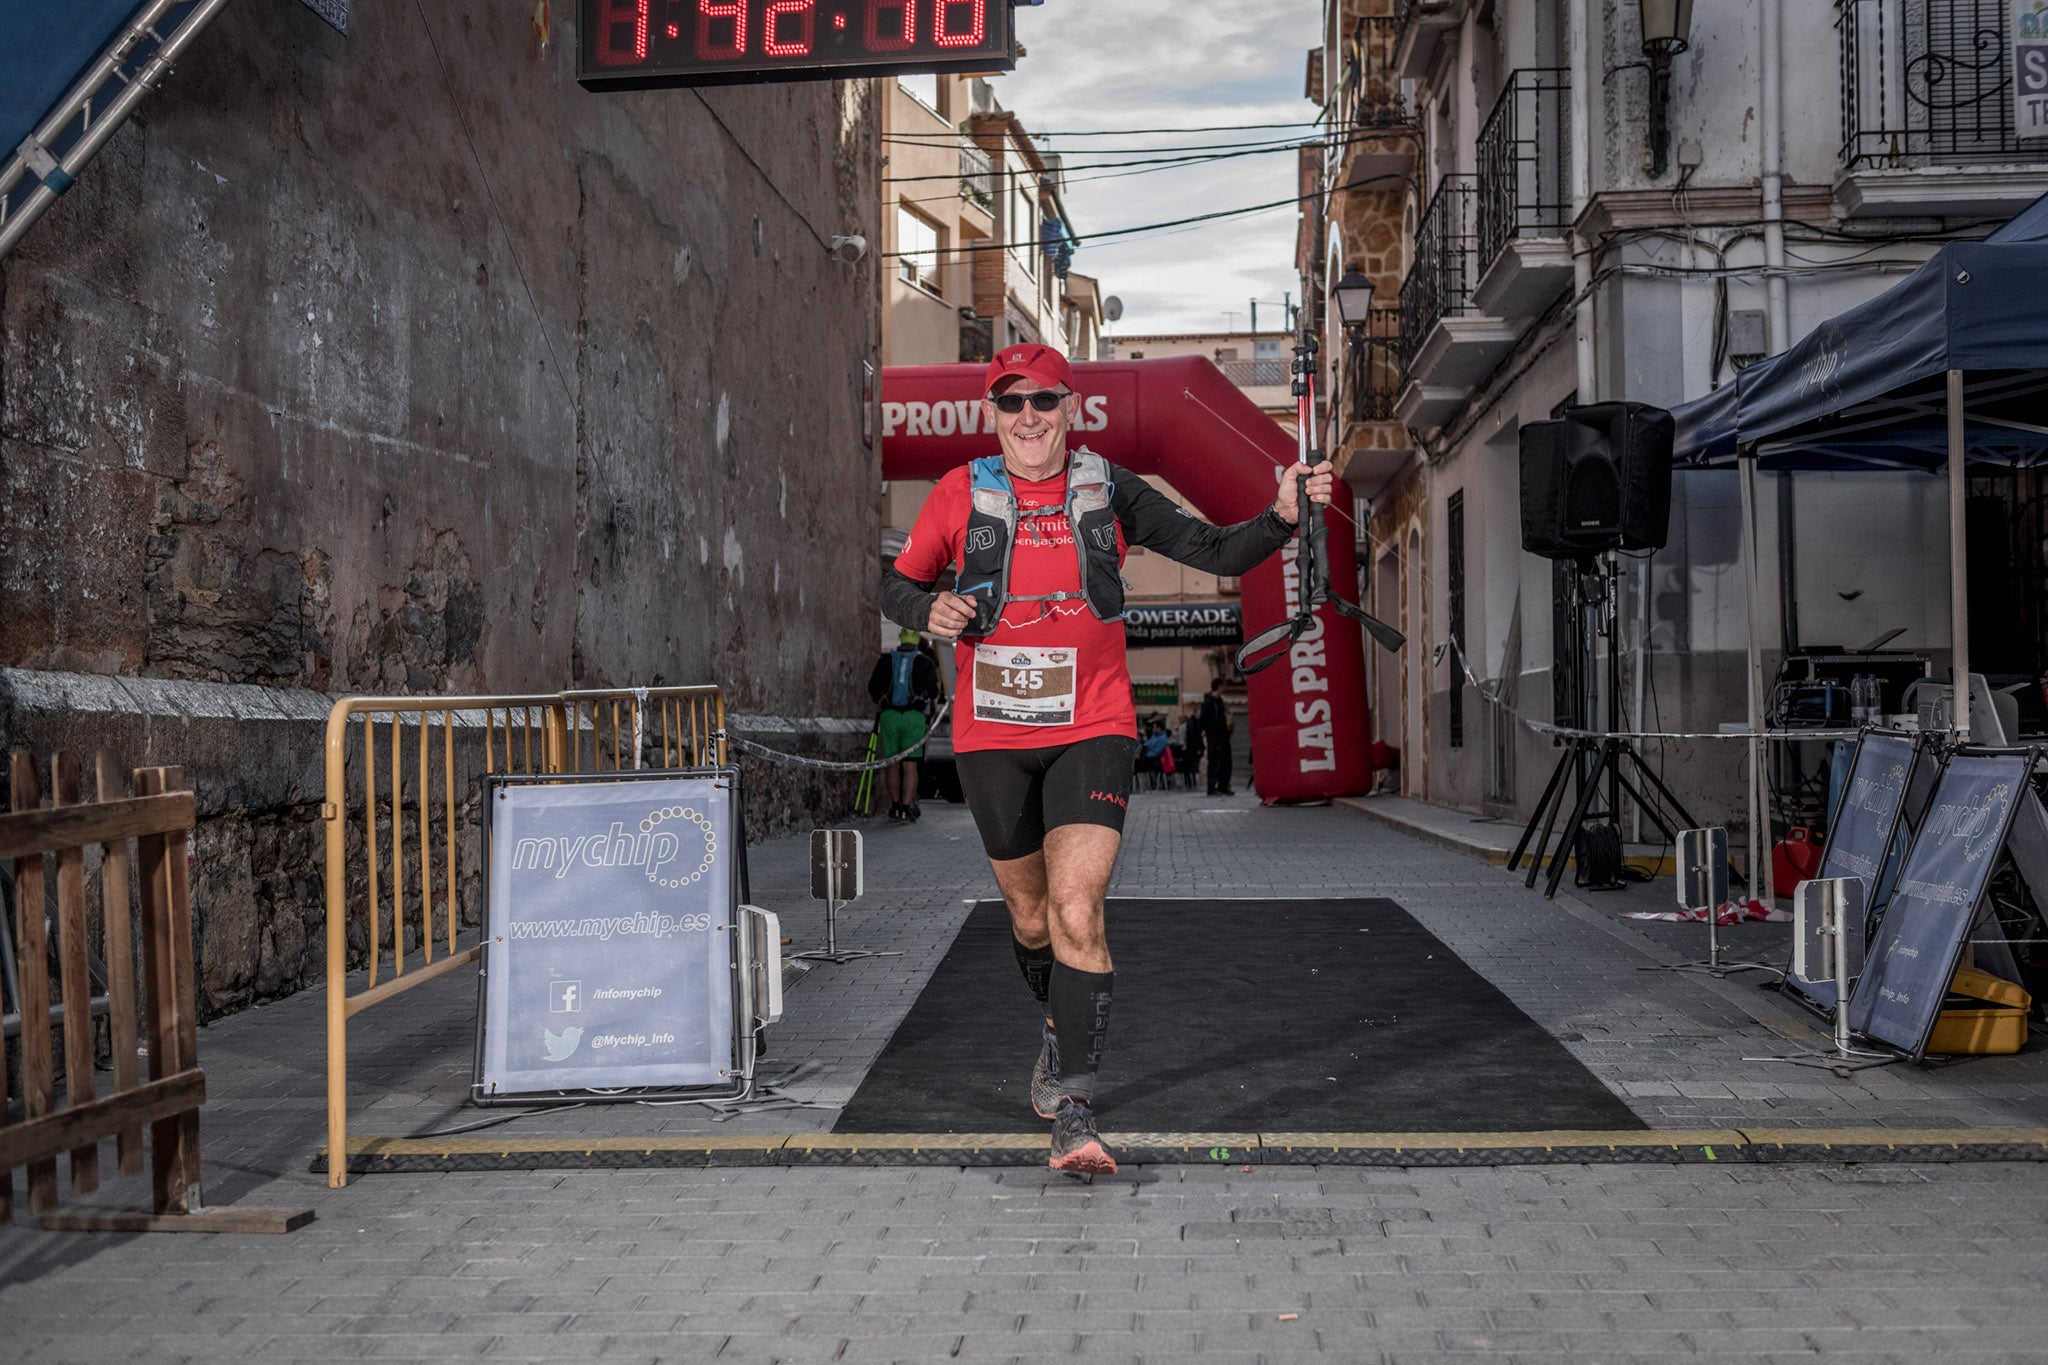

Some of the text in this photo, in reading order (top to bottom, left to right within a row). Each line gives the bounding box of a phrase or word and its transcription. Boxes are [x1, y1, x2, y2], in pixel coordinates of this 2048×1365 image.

[1126, 608, 1237, 625] OWERADE.
[1001, 669, 1044, 690] 145
[1297, 699, 1336, 773] LAS
[512, 822, 679, 879] mychip
[509, 911, 711, 941] www.mychip.es
[592, 986, 662, 1001] /infomychip
[591, 1033, 675, 1049] @Mychip_Info
